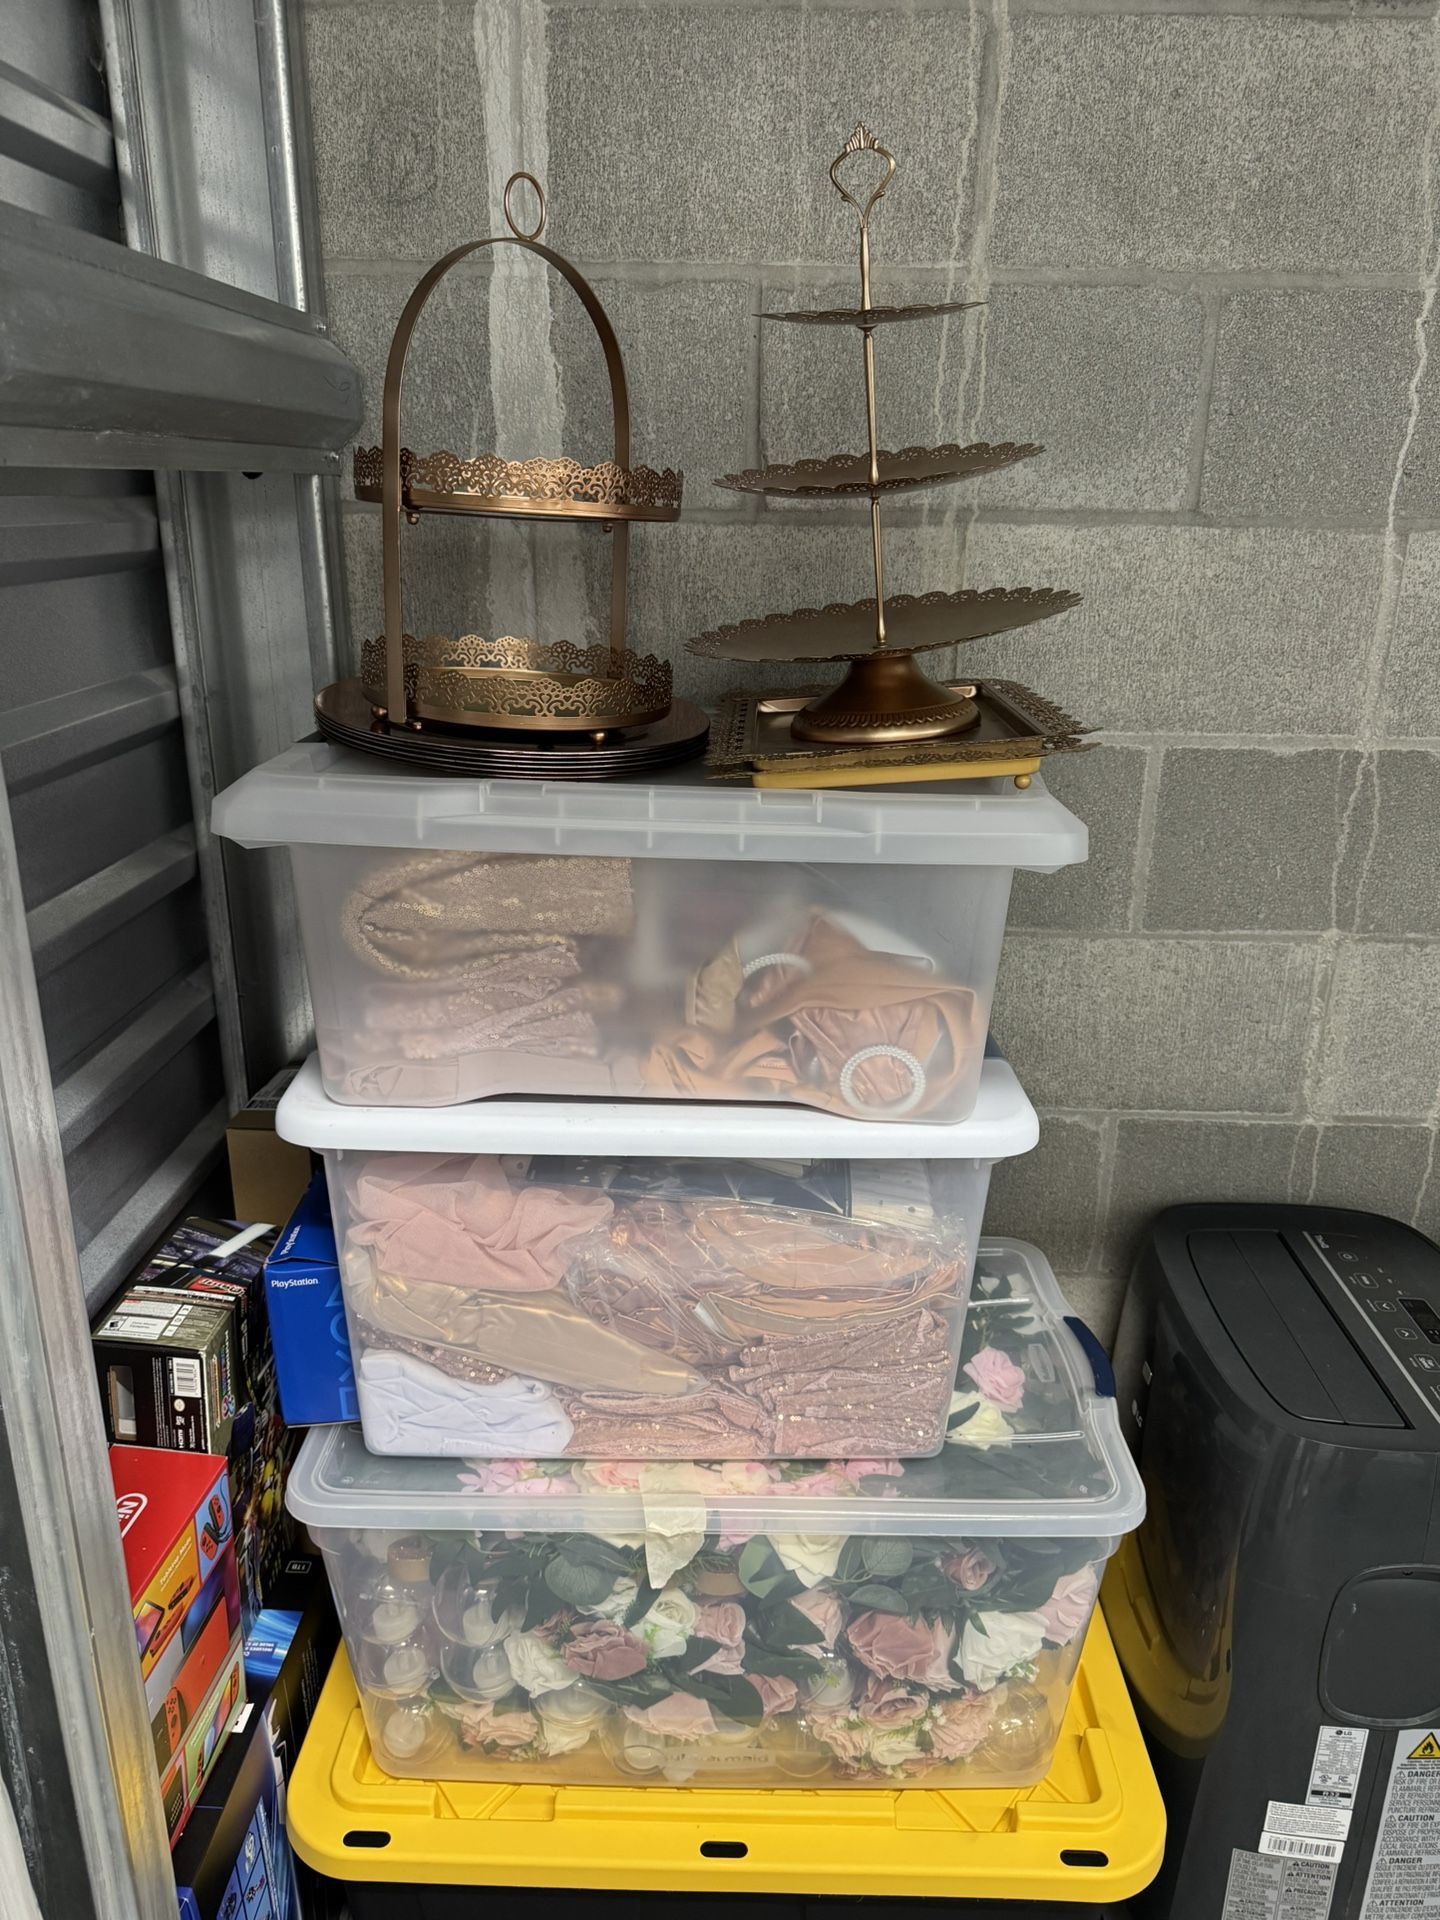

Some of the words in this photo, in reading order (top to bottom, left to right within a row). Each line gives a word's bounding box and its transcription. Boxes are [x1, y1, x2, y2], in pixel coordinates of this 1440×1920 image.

[271, 1278, 318, 1290] PlayStation
[1398, 1814, 1435, 1822] CAUTION
[1300, 1861, 1330, 1870] CAUTION
[1295, 1871, 1331, 1880] ATTENTION
